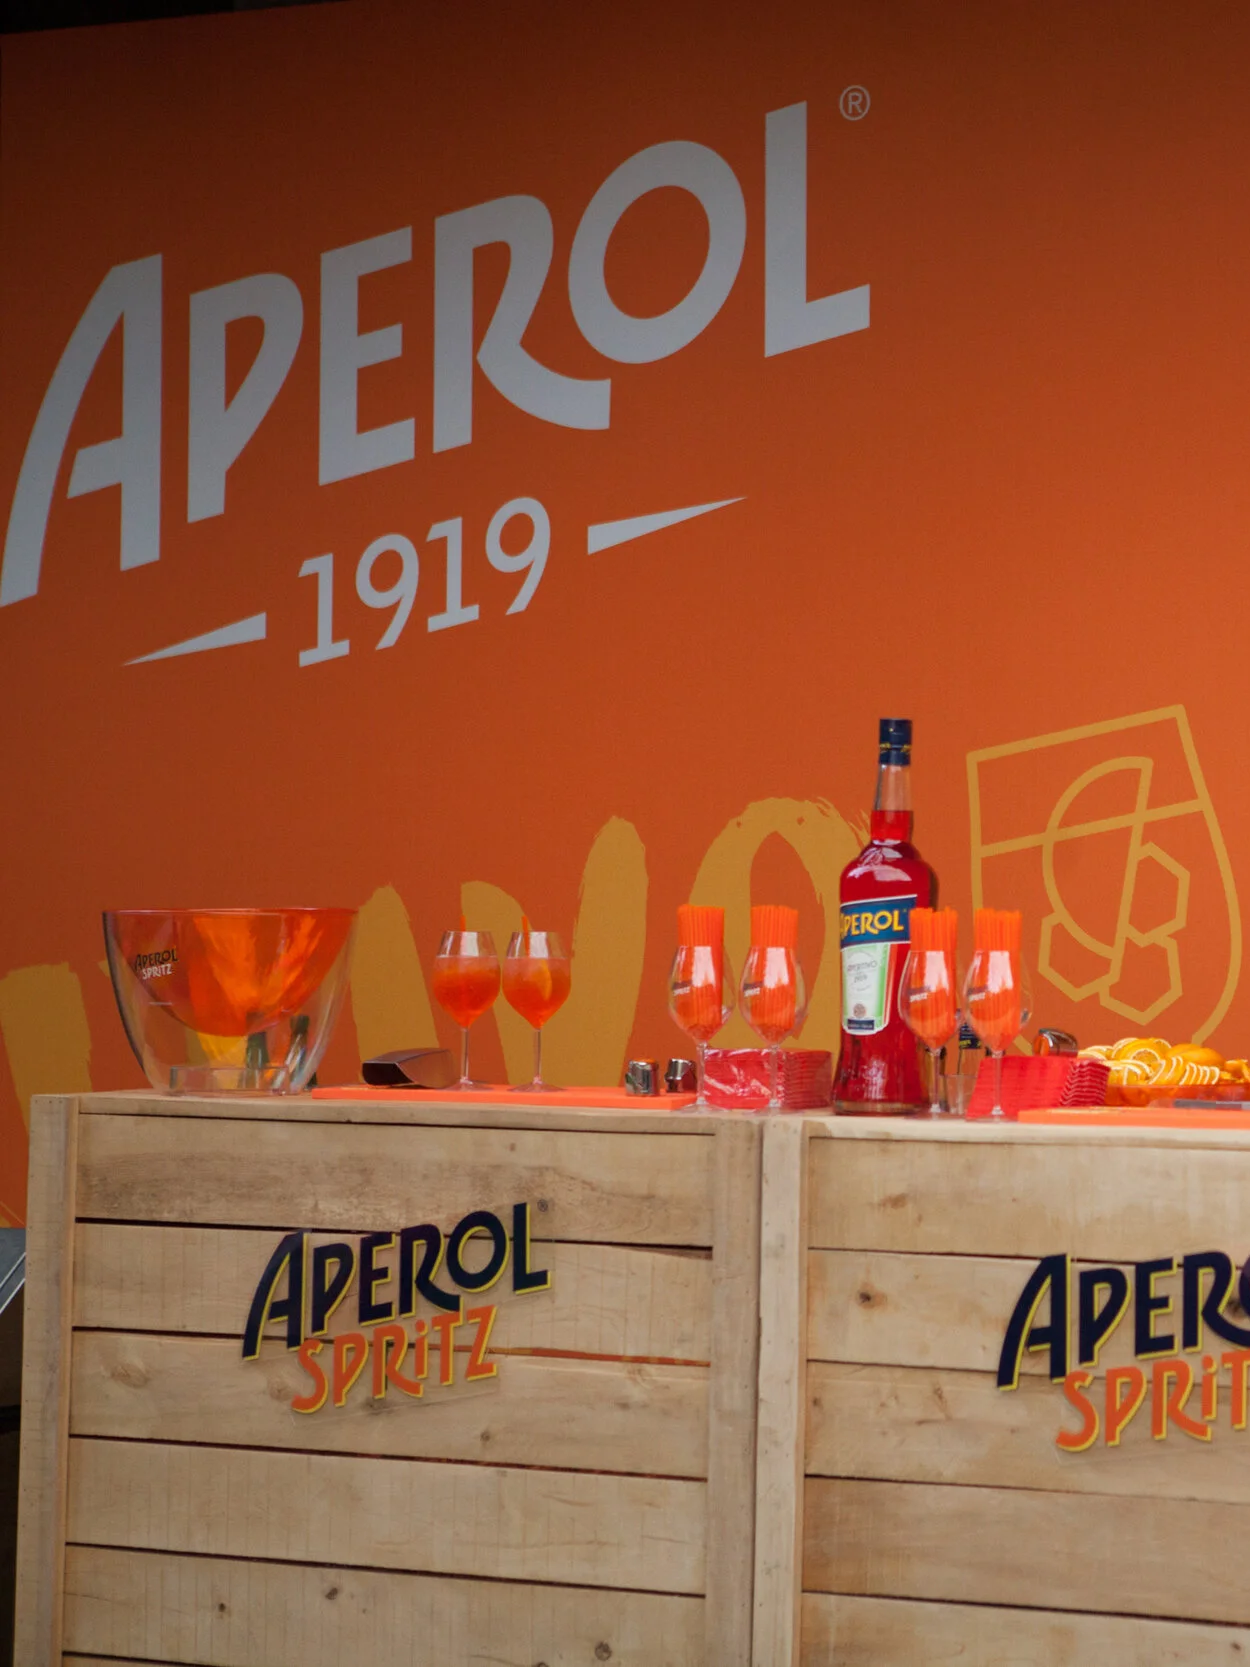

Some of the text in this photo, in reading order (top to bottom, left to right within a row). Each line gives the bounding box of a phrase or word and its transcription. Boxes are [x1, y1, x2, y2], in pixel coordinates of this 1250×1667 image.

[0, 100, 871, 603] APEROL
[298, 496, 552, 667] 1919
[134, 948, 178, 972] APEROL
[242, 1202, 551, 1361] APEROL
